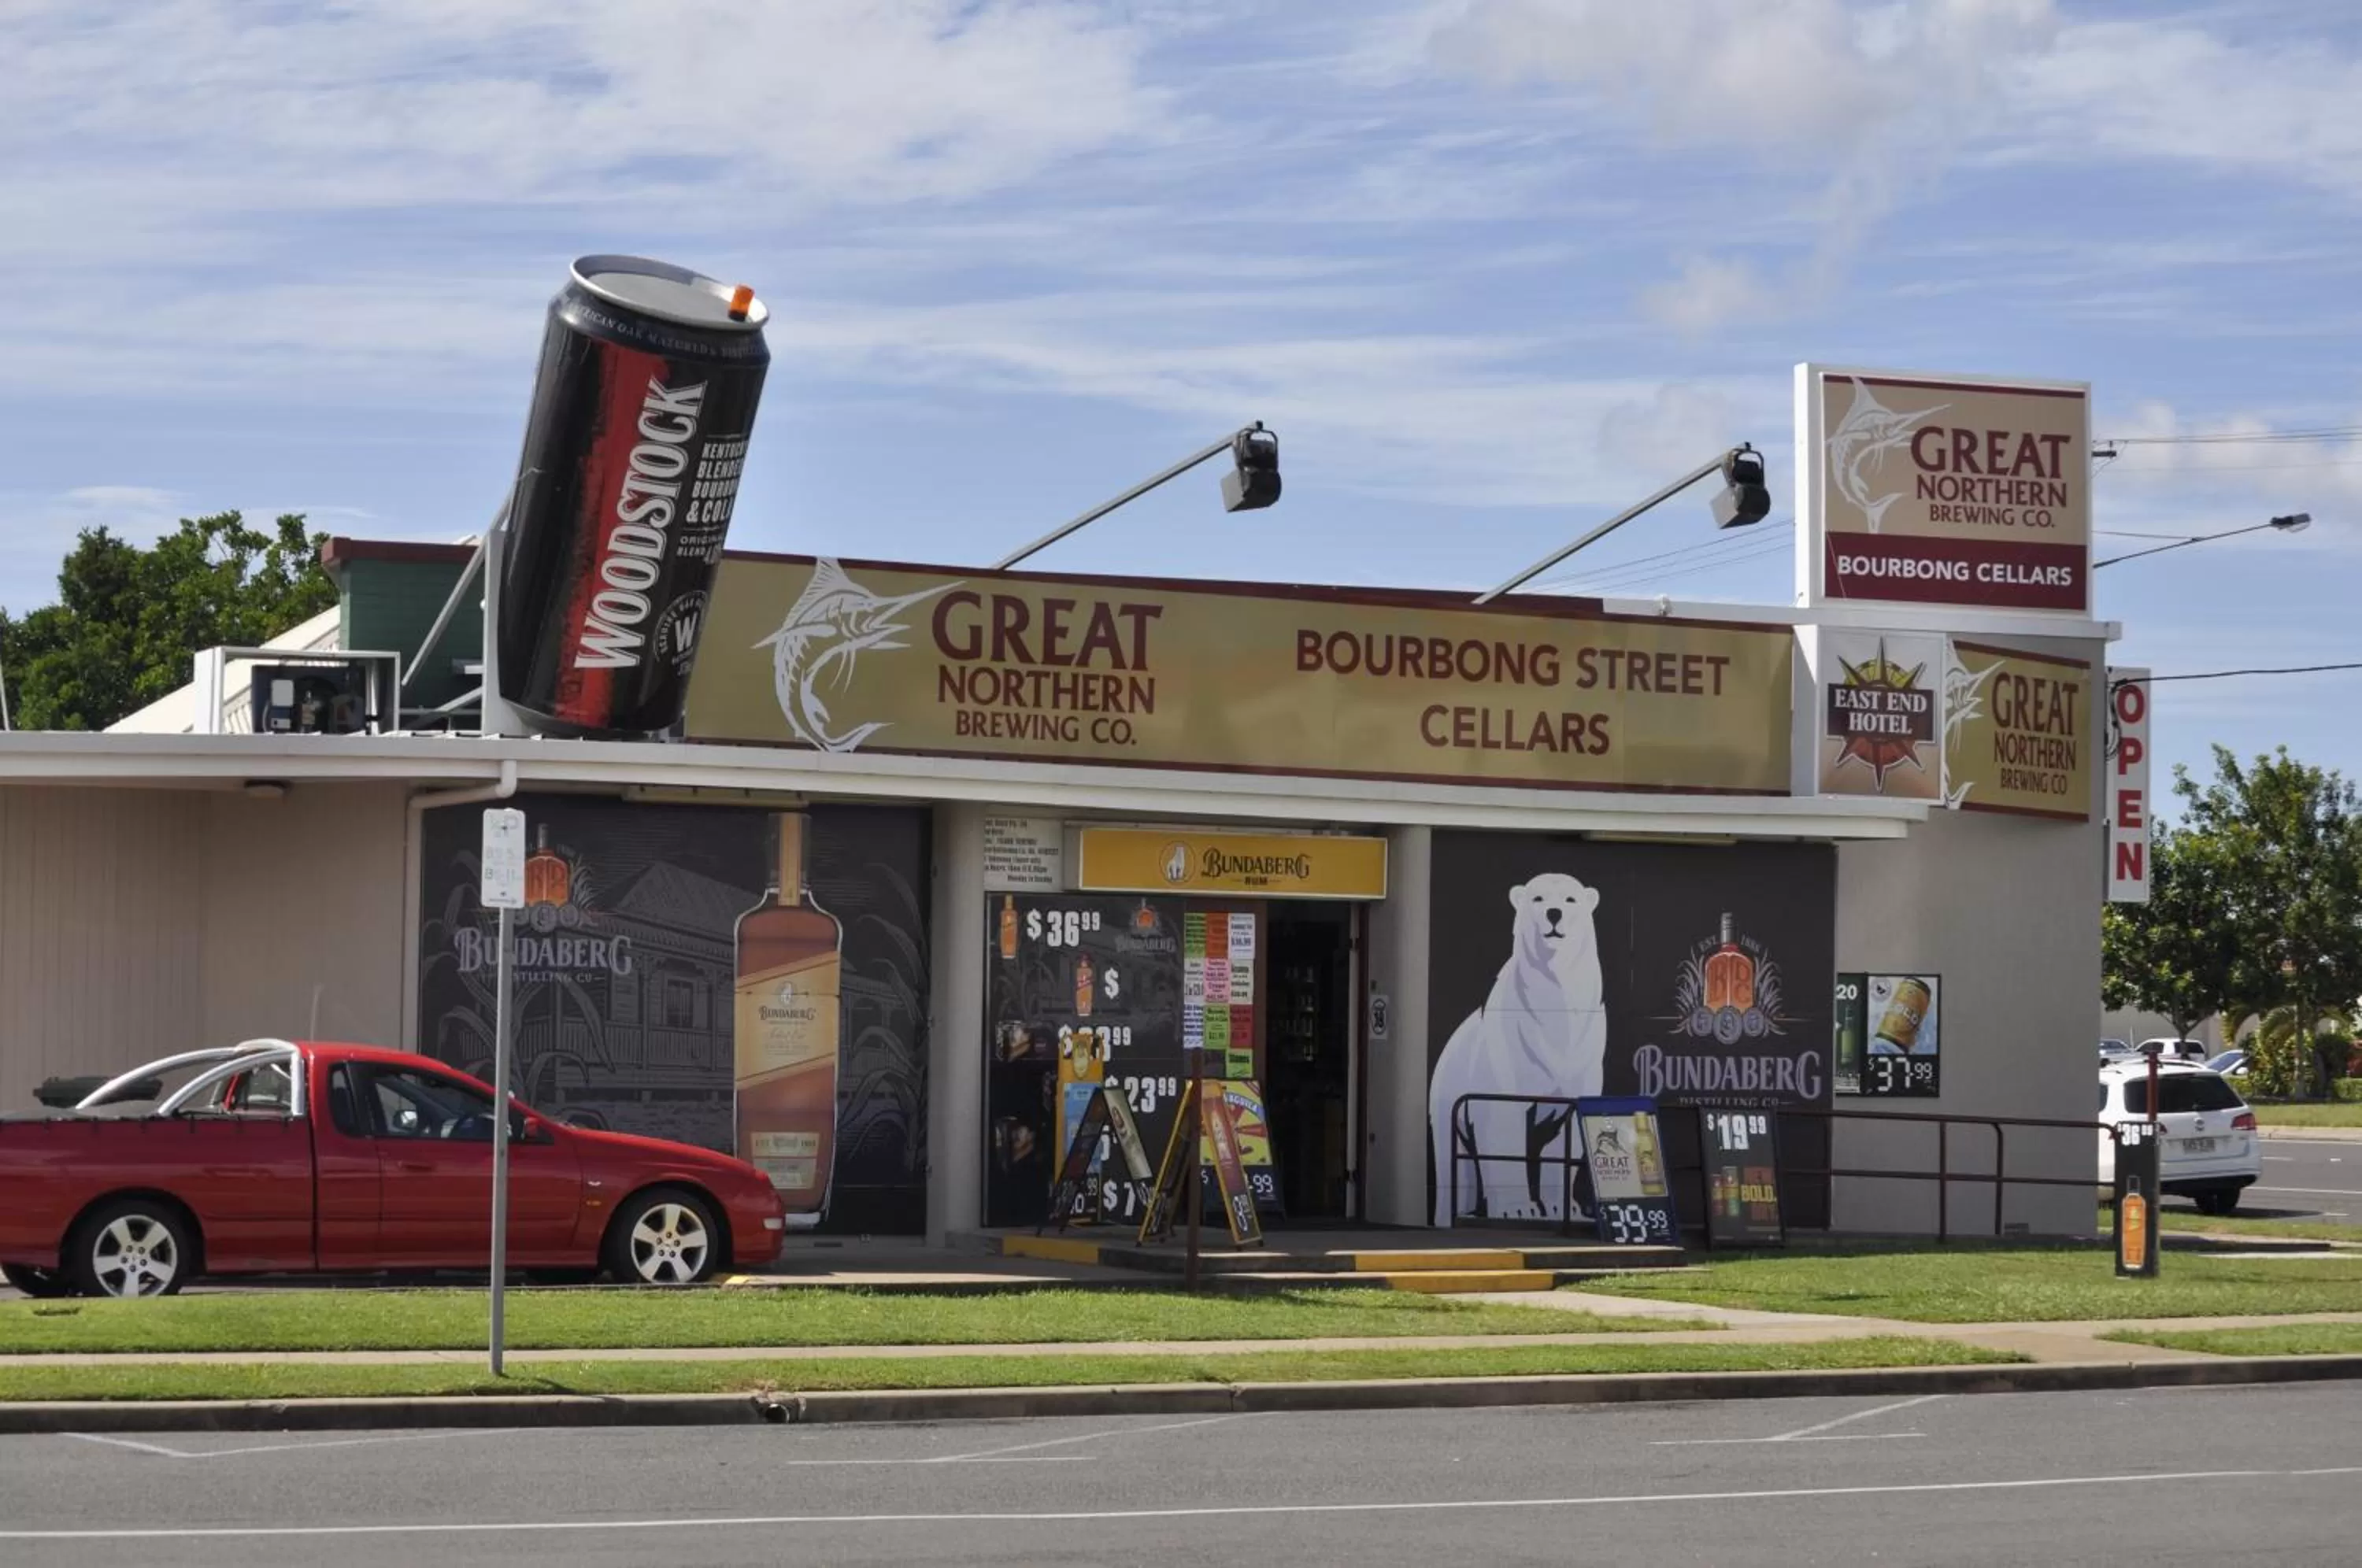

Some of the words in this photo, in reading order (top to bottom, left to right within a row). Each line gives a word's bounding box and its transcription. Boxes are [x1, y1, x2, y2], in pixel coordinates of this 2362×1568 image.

[1910, 426, 2071, 479] GREAT
[1916, 474, 2068, 508] NORTHERN
[574, 376, 709, 668] WOODSTOCK
[1930, 504, 2015, 527] BREWING
[2023, 508, 2055, 528] CO.
[1838, 555, 1969, 581] BOURBONG
[1976, 562, 2072, 586] CELLARS
[931, 590, 1164, 671] GREAT
[1296, 629, 1560, 686] BOURBONG
[1576, 647, 1730, 696] STREET
[938, 666, 1155, 714] NORTHERN
[1834, 688, 1883, 712] EAST
[1887, 693, 1927, 713] END
[1991, 671, 2079, 737] GREAT
[956, 710, 1079, 741] BREWING
[1091, 717, 1138, 746] CO.
[1420, 704, 1610, 756] CELLARS
[1849, 711, 1913, 735] HOTEL
[1994, 730, 2076, 771] NORTHERN
[2001, 767, 2048, 794] BREWING
[2051, 774, 2068, 795] CO
[2116, 683, 2145, 882] OPEN
[1201, 846, 1313, 879] BUNDABERG
[454, 926, 632, 975] BUDABERG
[1835, 984, 1857, 1000] 20
[1633, 1044, 1822, 1099] BUNDABERG
[1594, 1156, 1630, 1168] GREAT
